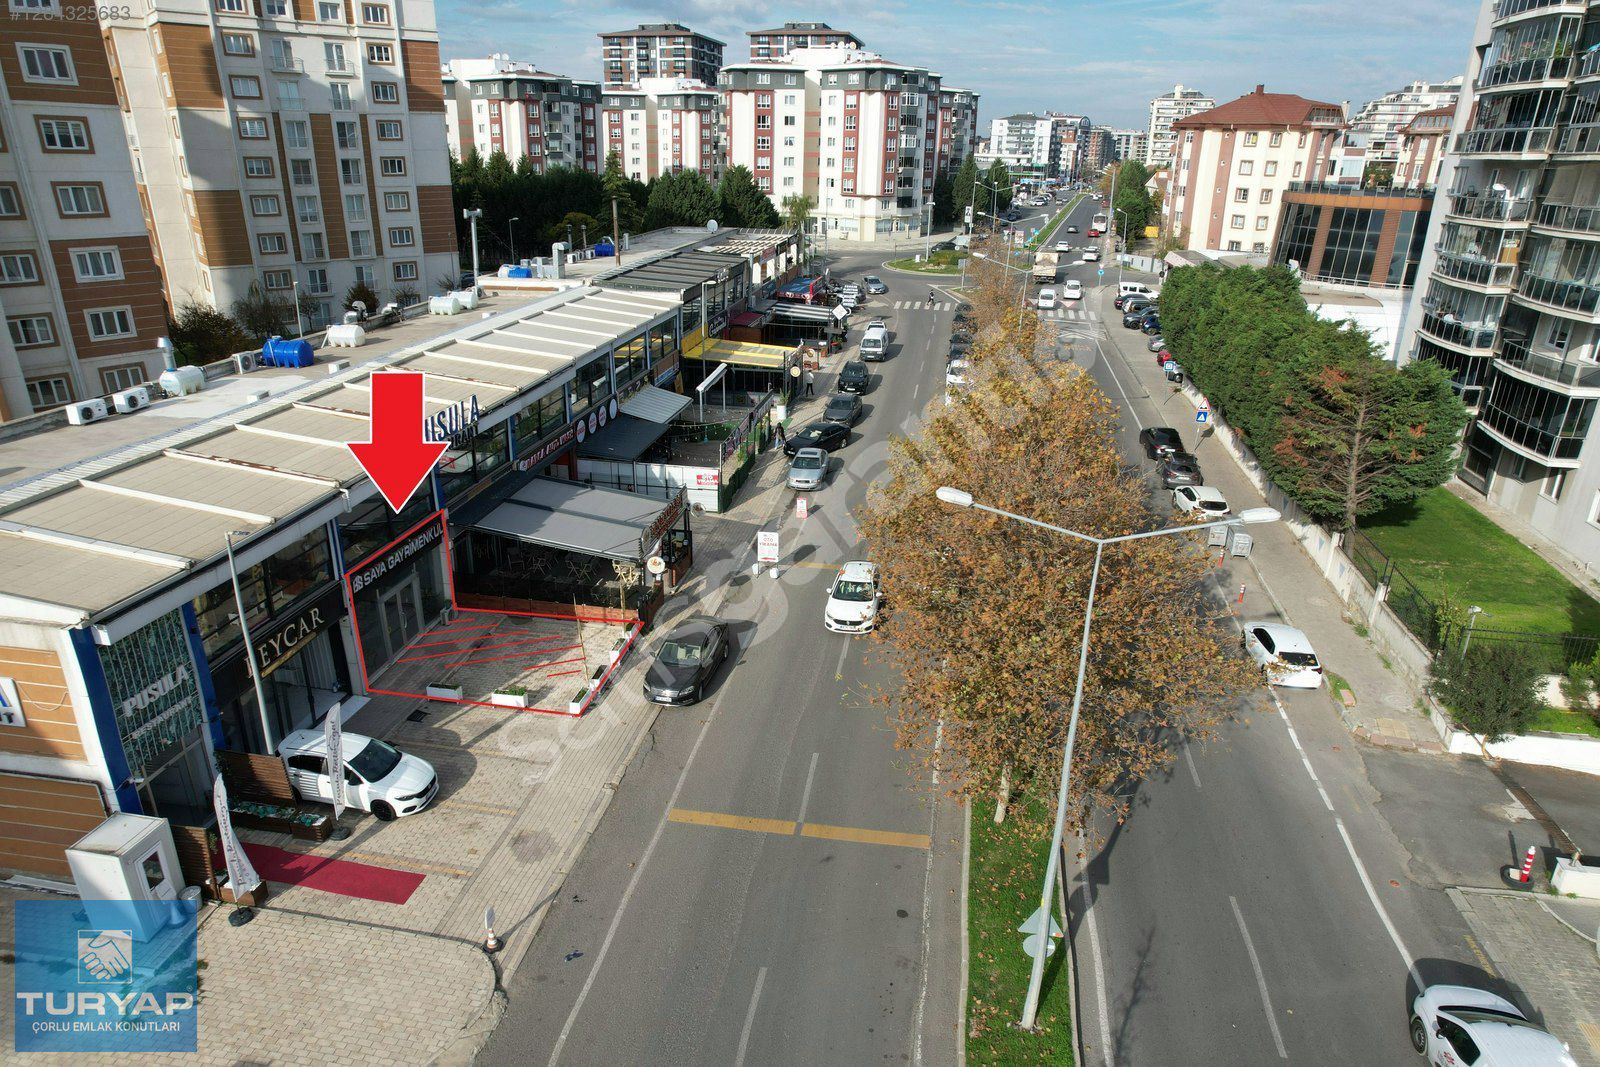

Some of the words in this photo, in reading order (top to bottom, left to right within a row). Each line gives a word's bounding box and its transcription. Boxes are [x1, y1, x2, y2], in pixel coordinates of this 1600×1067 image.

[363, 561, 387, 586] SAYA
[387, 522, 444, 570] GAYRİMENKUL
[122, 664, 190, 718] PUSULA
